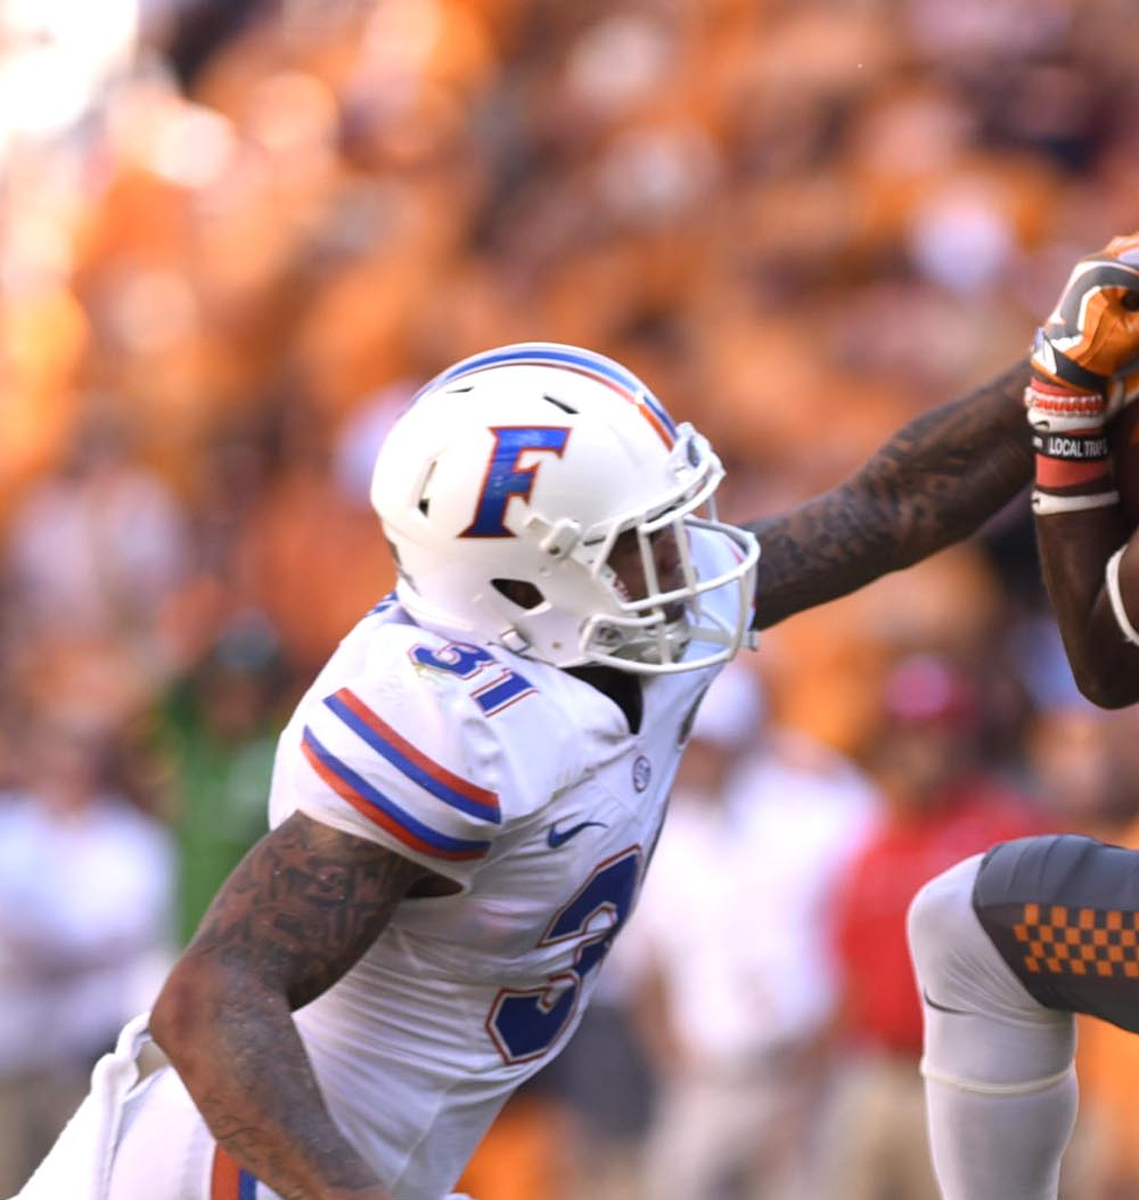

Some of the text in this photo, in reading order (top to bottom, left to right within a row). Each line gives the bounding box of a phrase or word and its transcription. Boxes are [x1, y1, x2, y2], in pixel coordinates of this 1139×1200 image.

[458, 427, 572, 539] F
[1050, 437, 1083, 458] LOCAL
[406, 642, 541, 718] 31
